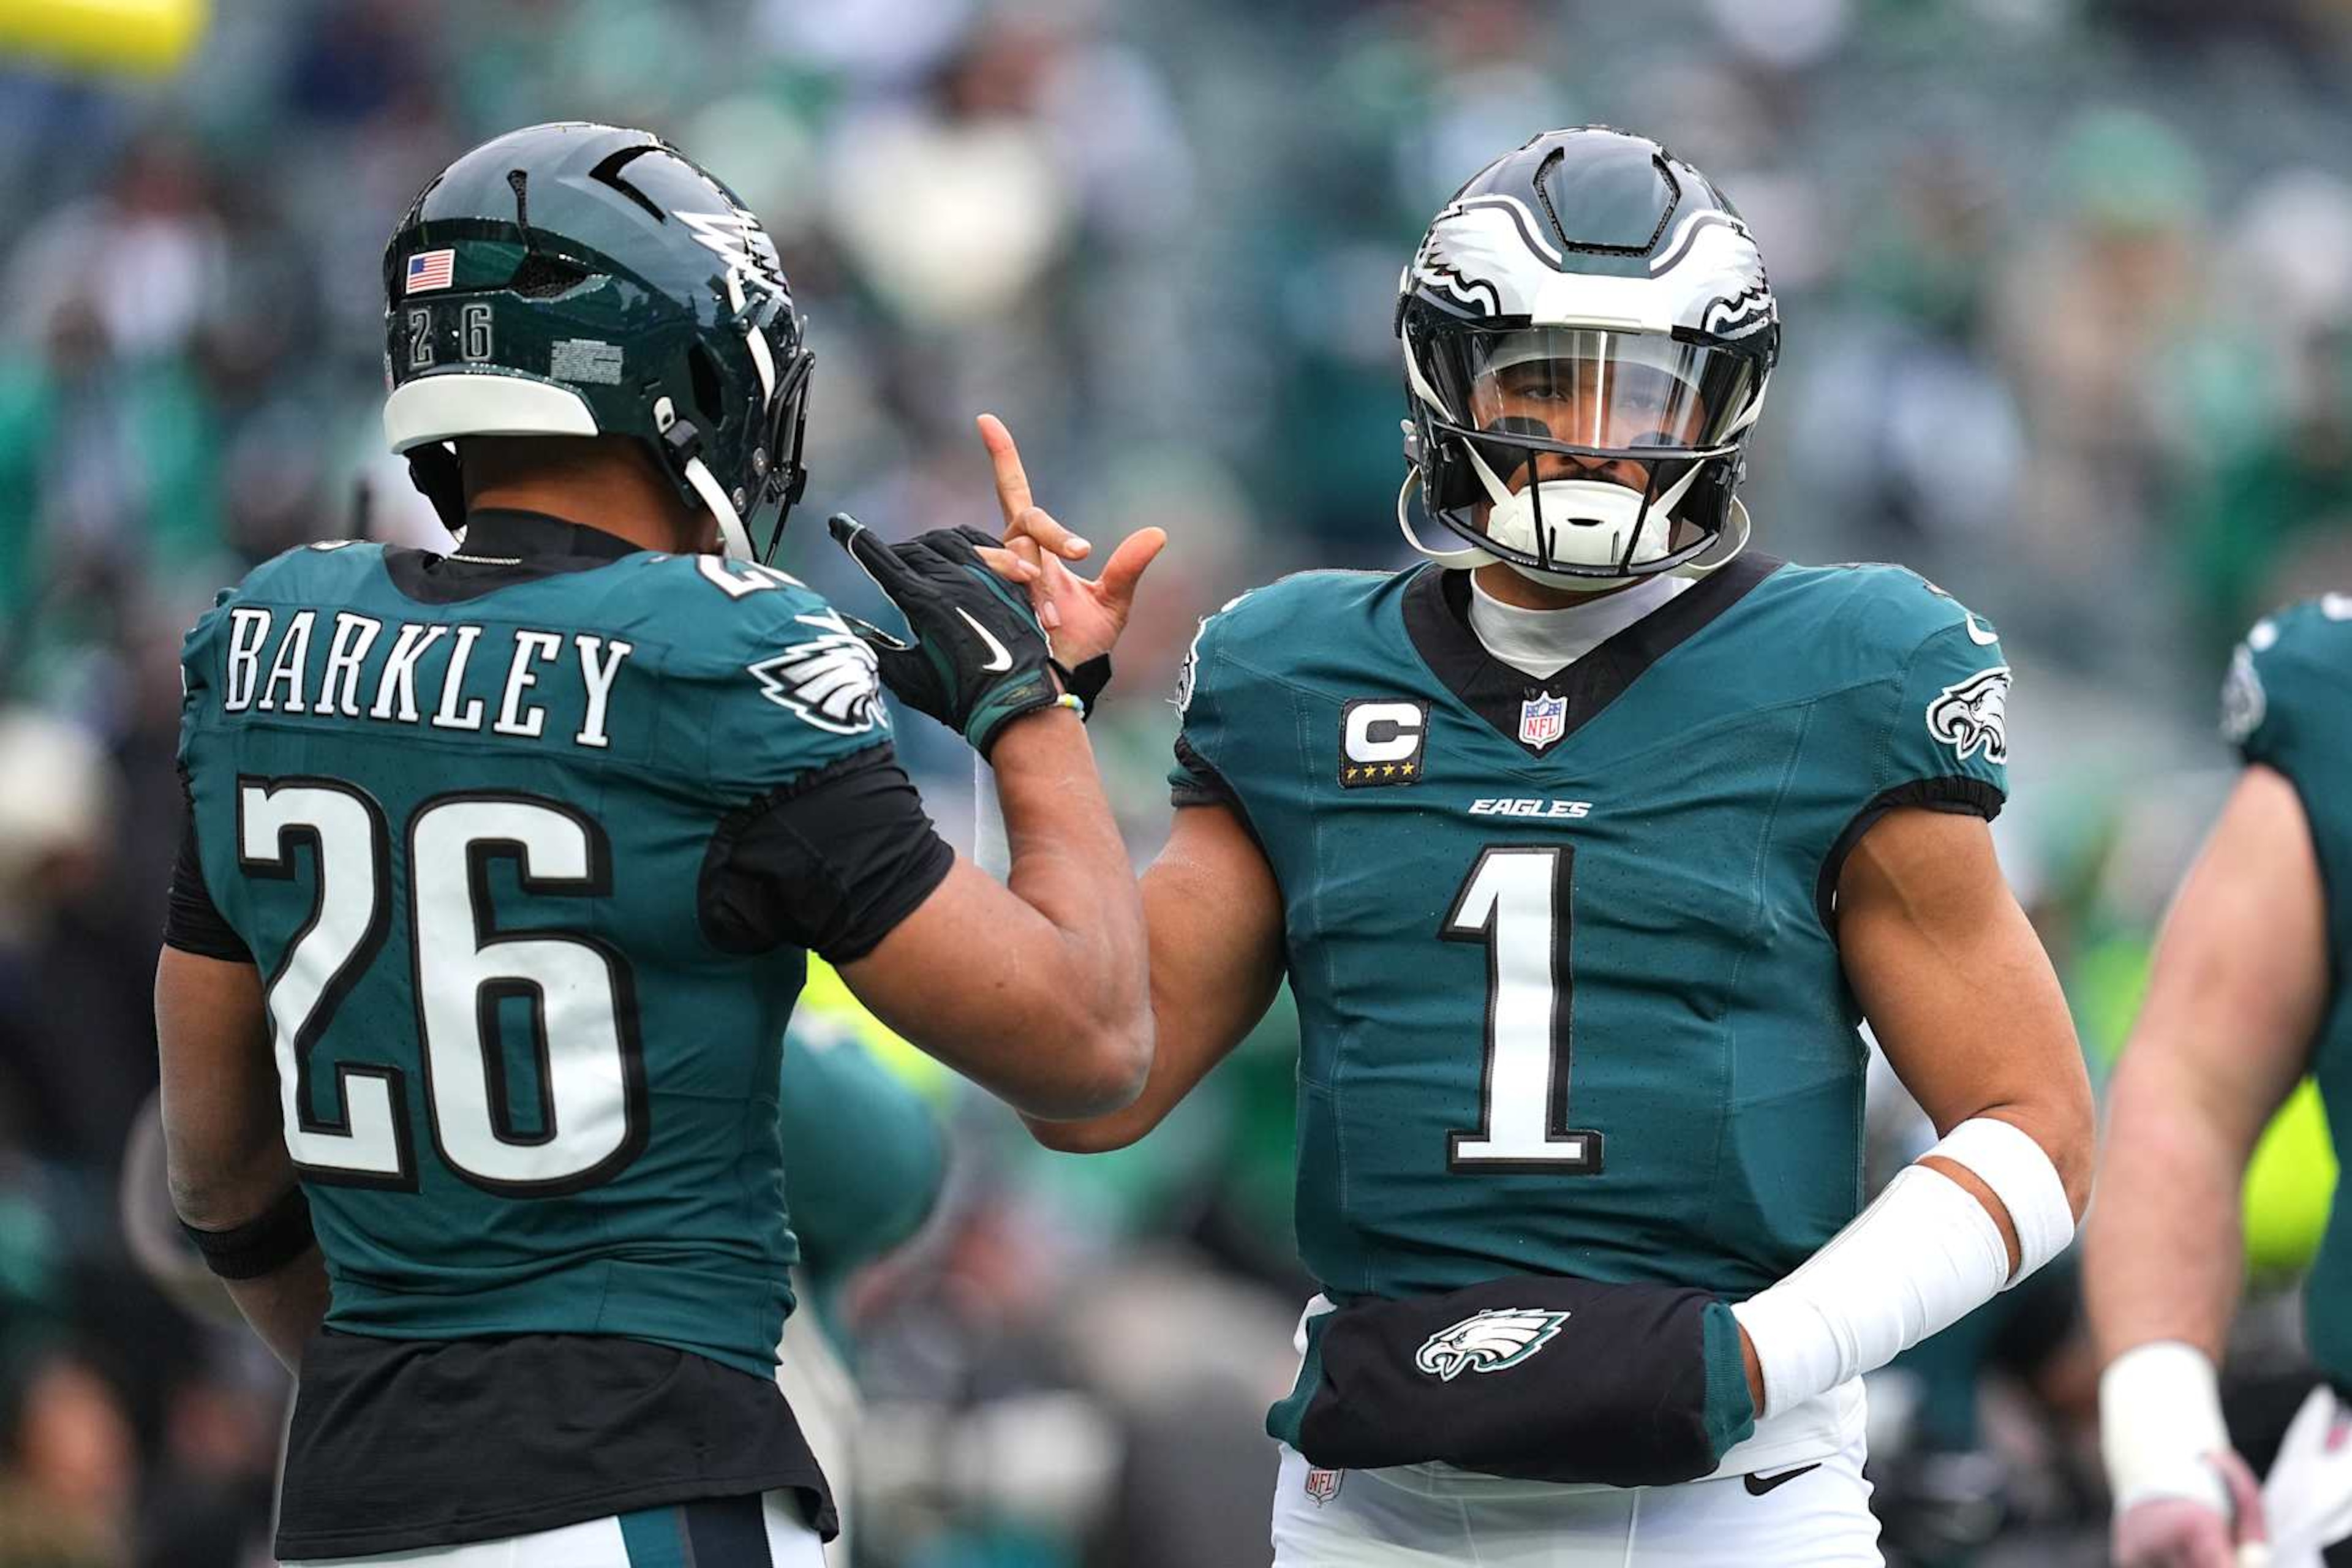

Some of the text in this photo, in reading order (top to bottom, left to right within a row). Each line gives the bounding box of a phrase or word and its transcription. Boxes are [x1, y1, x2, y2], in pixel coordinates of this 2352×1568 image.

[223, 606, 633, 750] BARKLEY
[1344, 703, 1423, 763] C
[1526, 717, 1556, 737] NFL
[1468, 798, 1594, 818] EAGLES
[237, 774, 650, 1199] 26
[1438, 842, 1604, 1175] 1
[1309, 1472, 1333, 1494] NFL
